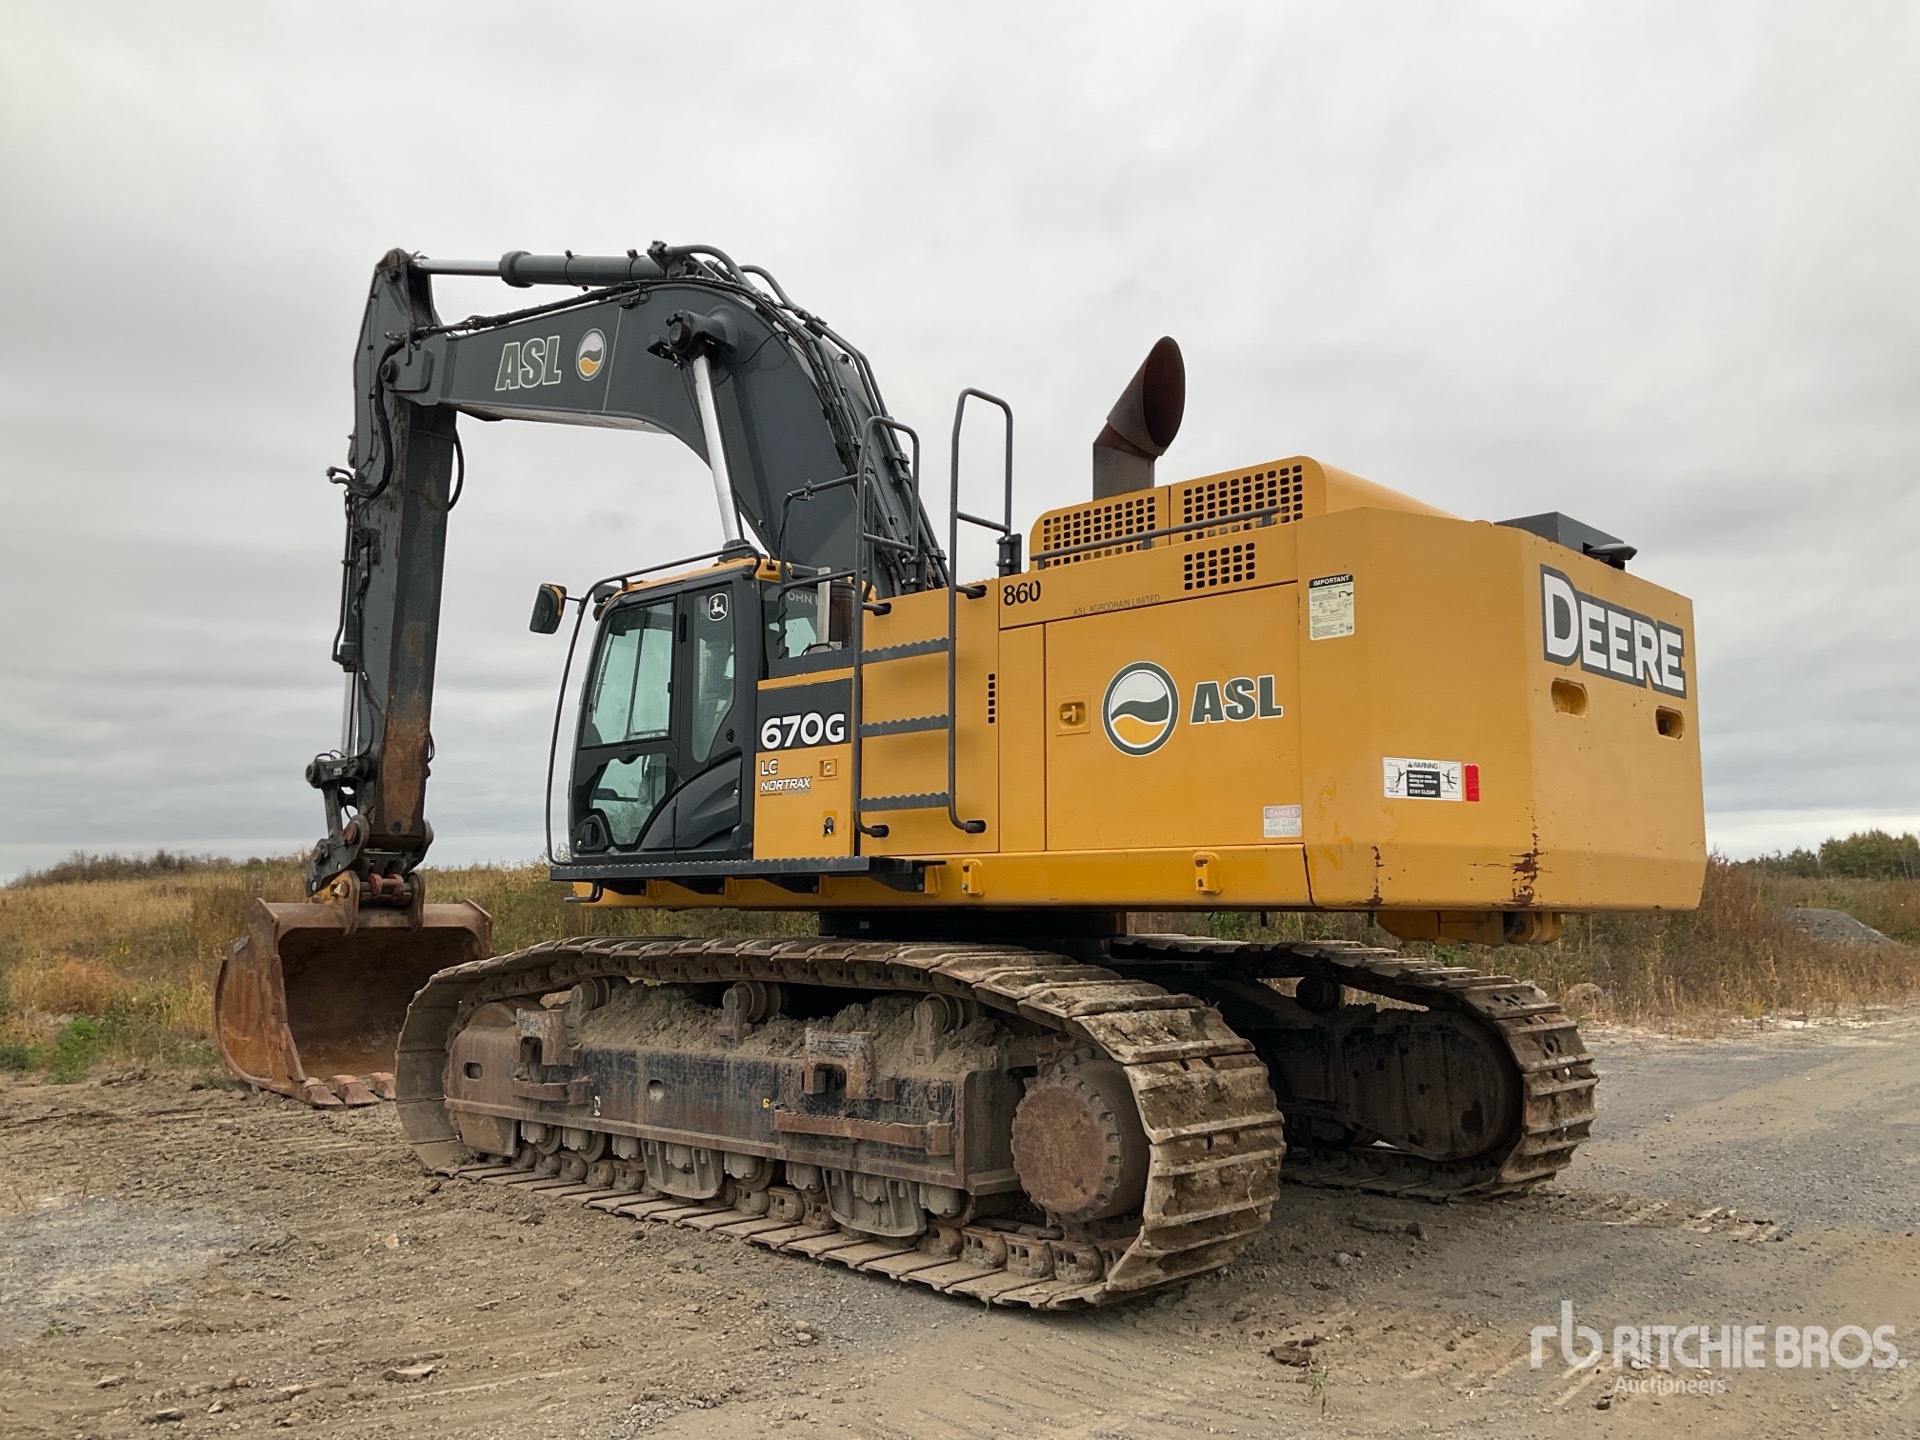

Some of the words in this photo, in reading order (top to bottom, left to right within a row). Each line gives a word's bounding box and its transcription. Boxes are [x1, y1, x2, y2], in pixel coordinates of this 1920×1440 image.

[494, 335, 562, 391] ASL
[1003, 579, 1042, 606] 860
[1313, 575, 1350, 587] IMPORTANT
[786, 591, 813, 605] OHN
[1073, 607, 1086, 616] ASL
[1089, 599, 1130, 613] AGRODRAIN
[1131, 593, 1160, 607] LIMITED
[1542, 571, 1686, 693] DEERE
[1190, 674, 1284, 725] ASL
[760, 711, 846, 750] 670G
[760, 759, 779, 777] LC
[1413, 761, 1438, 769] WARNING
[760, 776, 813, 792] NORTRAX
